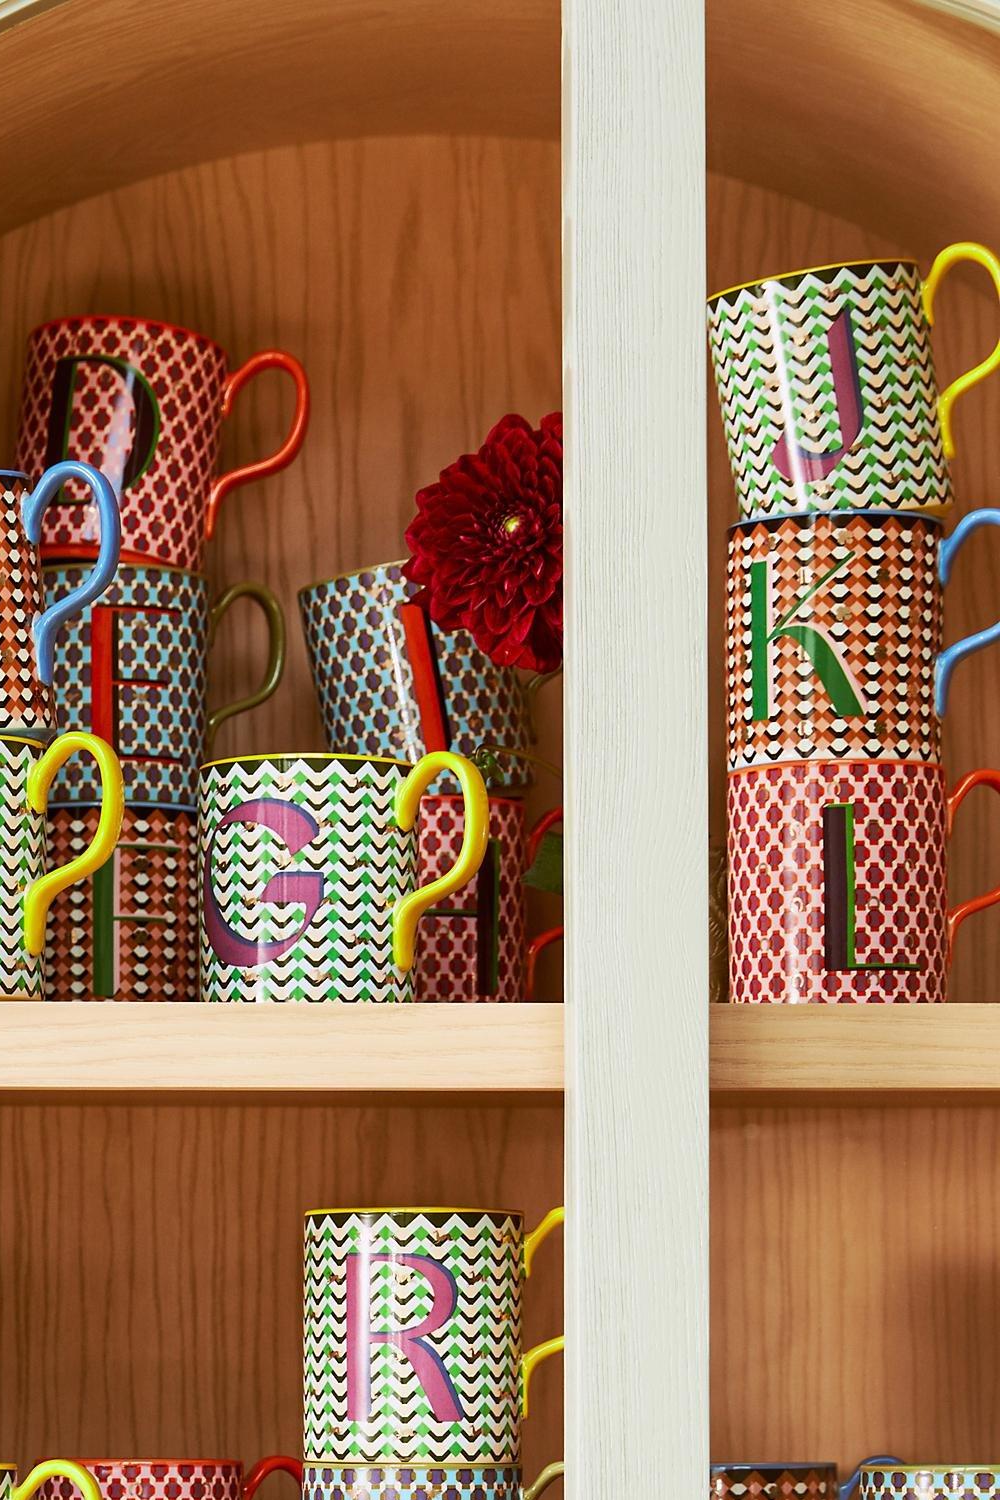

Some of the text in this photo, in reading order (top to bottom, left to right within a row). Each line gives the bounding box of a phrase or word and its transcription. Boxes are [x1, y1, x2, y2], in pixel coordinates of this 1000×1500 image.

[45, 355, 160, 503] D
[773, 303, 866, 482] J
[91, 605, 182, 764] E
[750, 551, 867, 720] K
[92, 843, 182, 999] F
[203, 798, 324, 967] G
[823, 803, 921, 971] L
[346, 1252, 463, 1422] R
